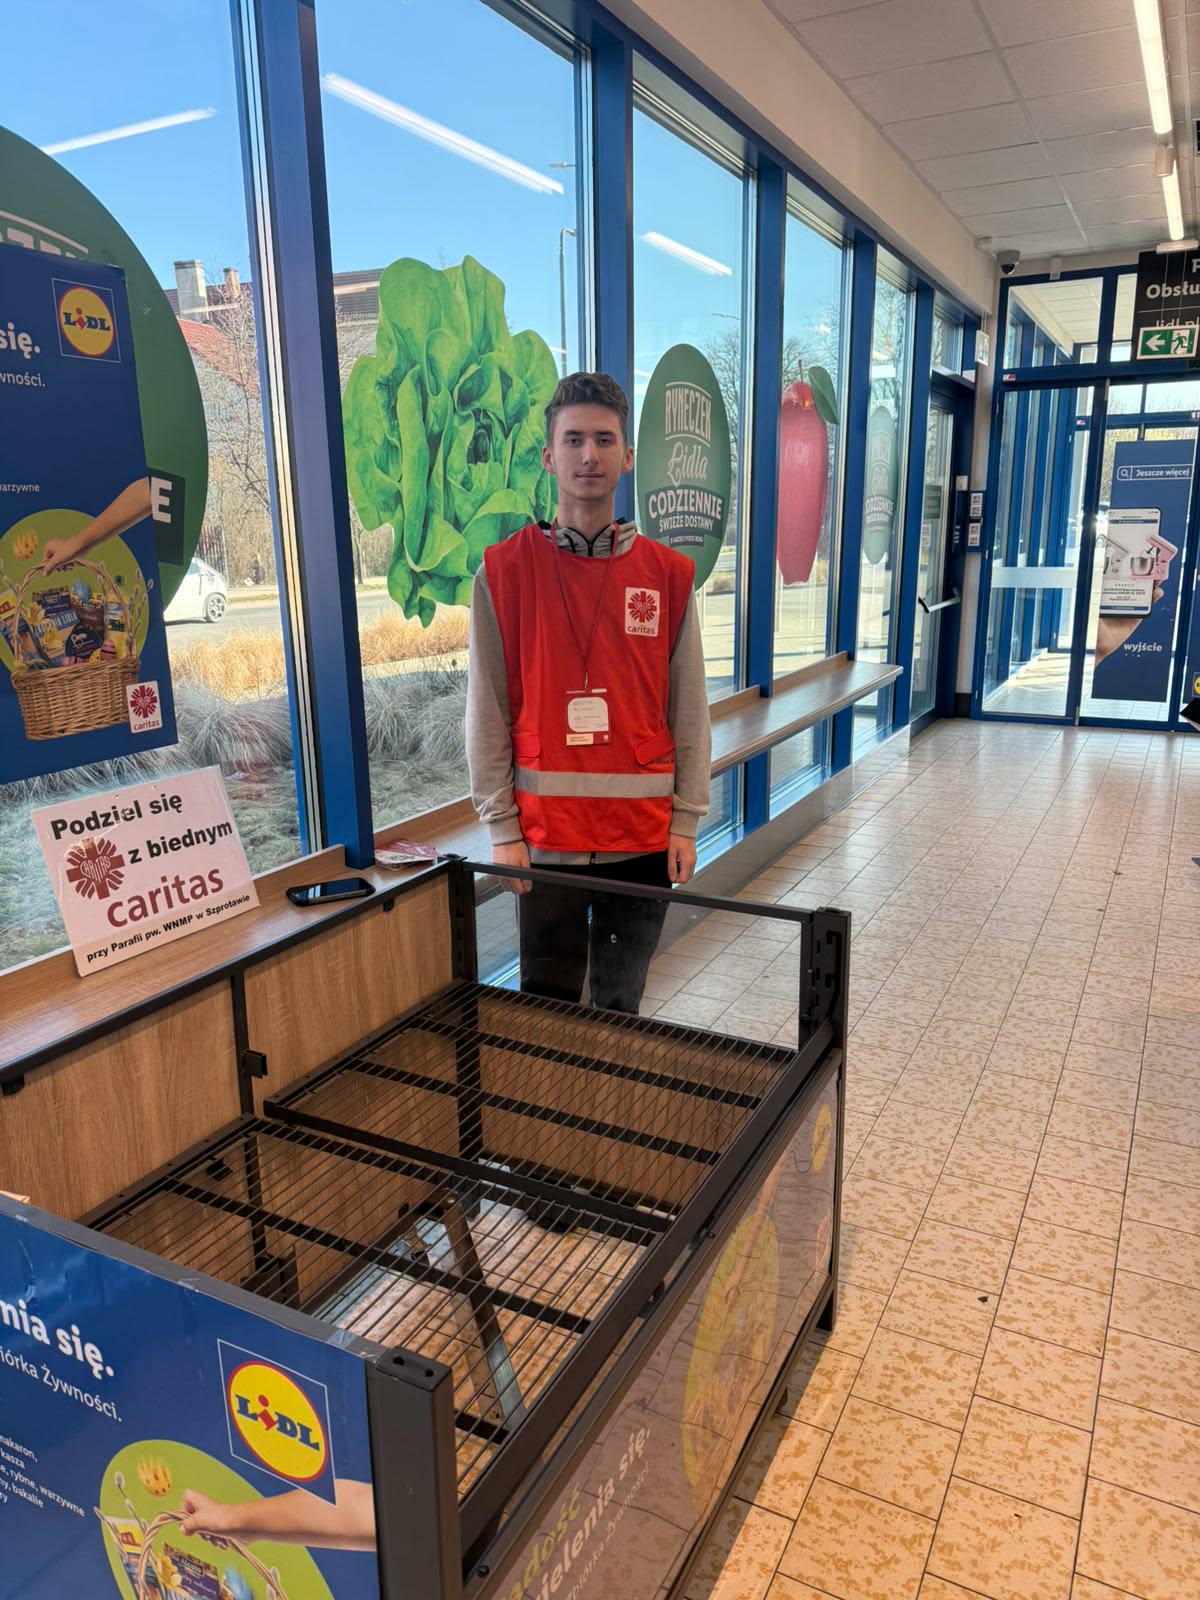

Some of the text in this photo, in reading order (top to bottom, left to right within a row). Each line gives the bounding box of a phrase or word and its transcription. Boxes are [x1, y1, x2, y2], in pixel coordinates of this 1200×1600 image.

[665, 387, 711, 442] RYNECZEK
[667, 442, 708, 487] Lidla
[0, 483, 40, 495] arzywne
[648, 490, 722, 521] CODZIENNIE
[659, 516, 714, 533] ŚWIEŻE DOSTAWY
[628, 624, 656, 635] caritas
[1123, 642, 1162, 653] wyjście
[133, 720, 160, 731] caritas
[51, 794, 182, 839] Podziel się
[128, 822, 233, 864] z biednym
[106, 868, 224, 928] caritas
[86, 948, 109, 963] przy
[163, 914, 194, 932] WNMP
[56, 1325, 115, 1380] się.
[40, 1365, 123, 1423] Żywności.
[11, 1481, 44, 1509] bakalie
[39, 1484, 85, 1518] warzywne
